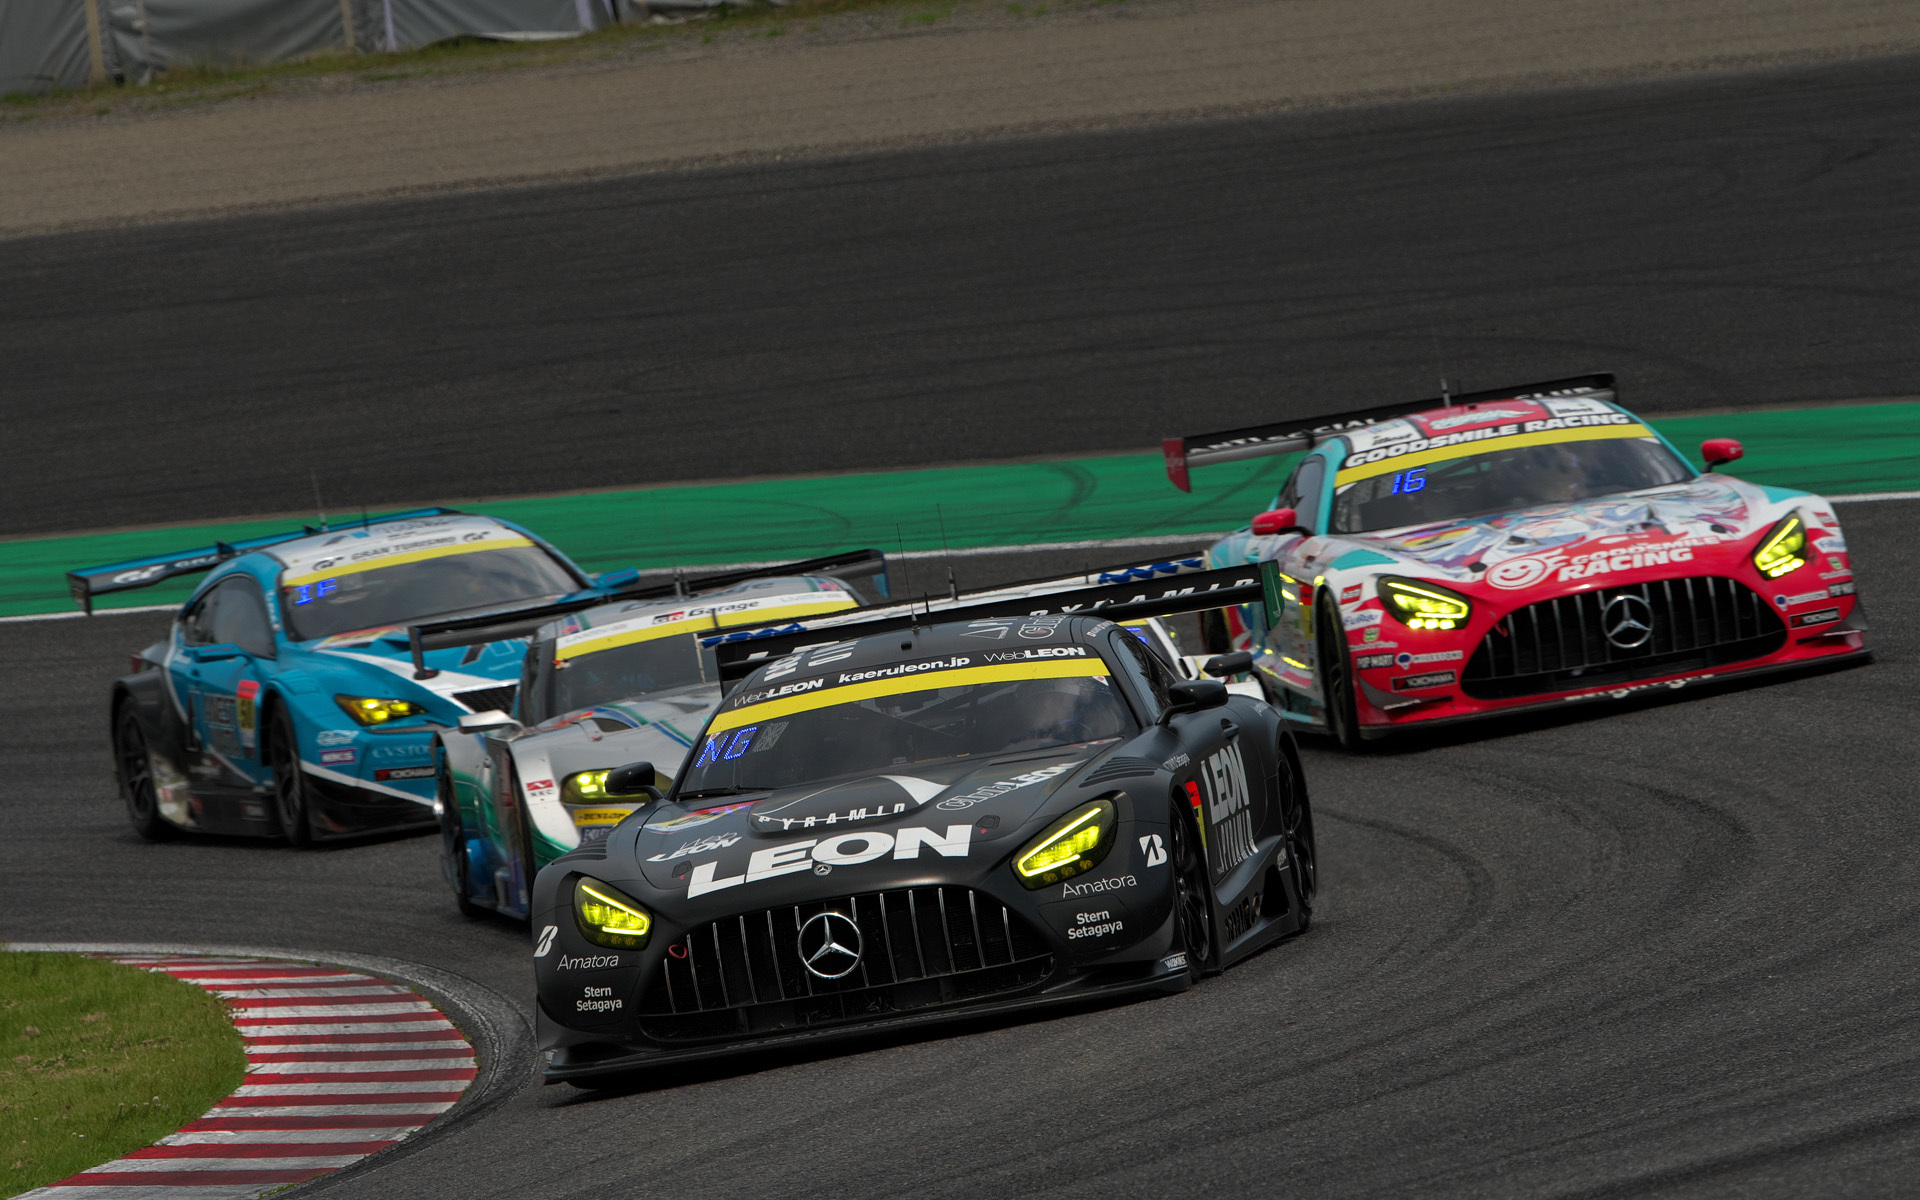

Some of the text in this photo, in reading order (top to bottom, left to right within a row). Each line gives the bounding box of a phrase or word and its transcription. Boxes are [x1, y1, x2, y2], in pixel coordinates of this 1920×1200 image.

[1345, 423, 1519, 468] GOODSMILE
[1524, 413, 1630, 433] RACING
[1570, 536, 1722, 565] GOODSMILE
[1557, 547, 1695, 582] RACING
[688, 600, 761, 618] Garage
[734, 678, 825, 708] WebLEON
[838, 656, 970, 684] kaeruleon.jp
[984, 646, 1087, 663] WebLEON
[1201, 740, 1250, 826] LEON
[758, 803, 906, 831] PYRAMID
[687, 824, 974, 899] LEON
[1062, 874, 1138, 899] Amatora
[1067, 920, 1124, 940] Setagaya
[1076, 910, 1110, 925] Stern
[556, 954, 620, 971] Amatora
[584, 986, 613, 998] Stern
[576, 999, 623, 1012] Setagaya
